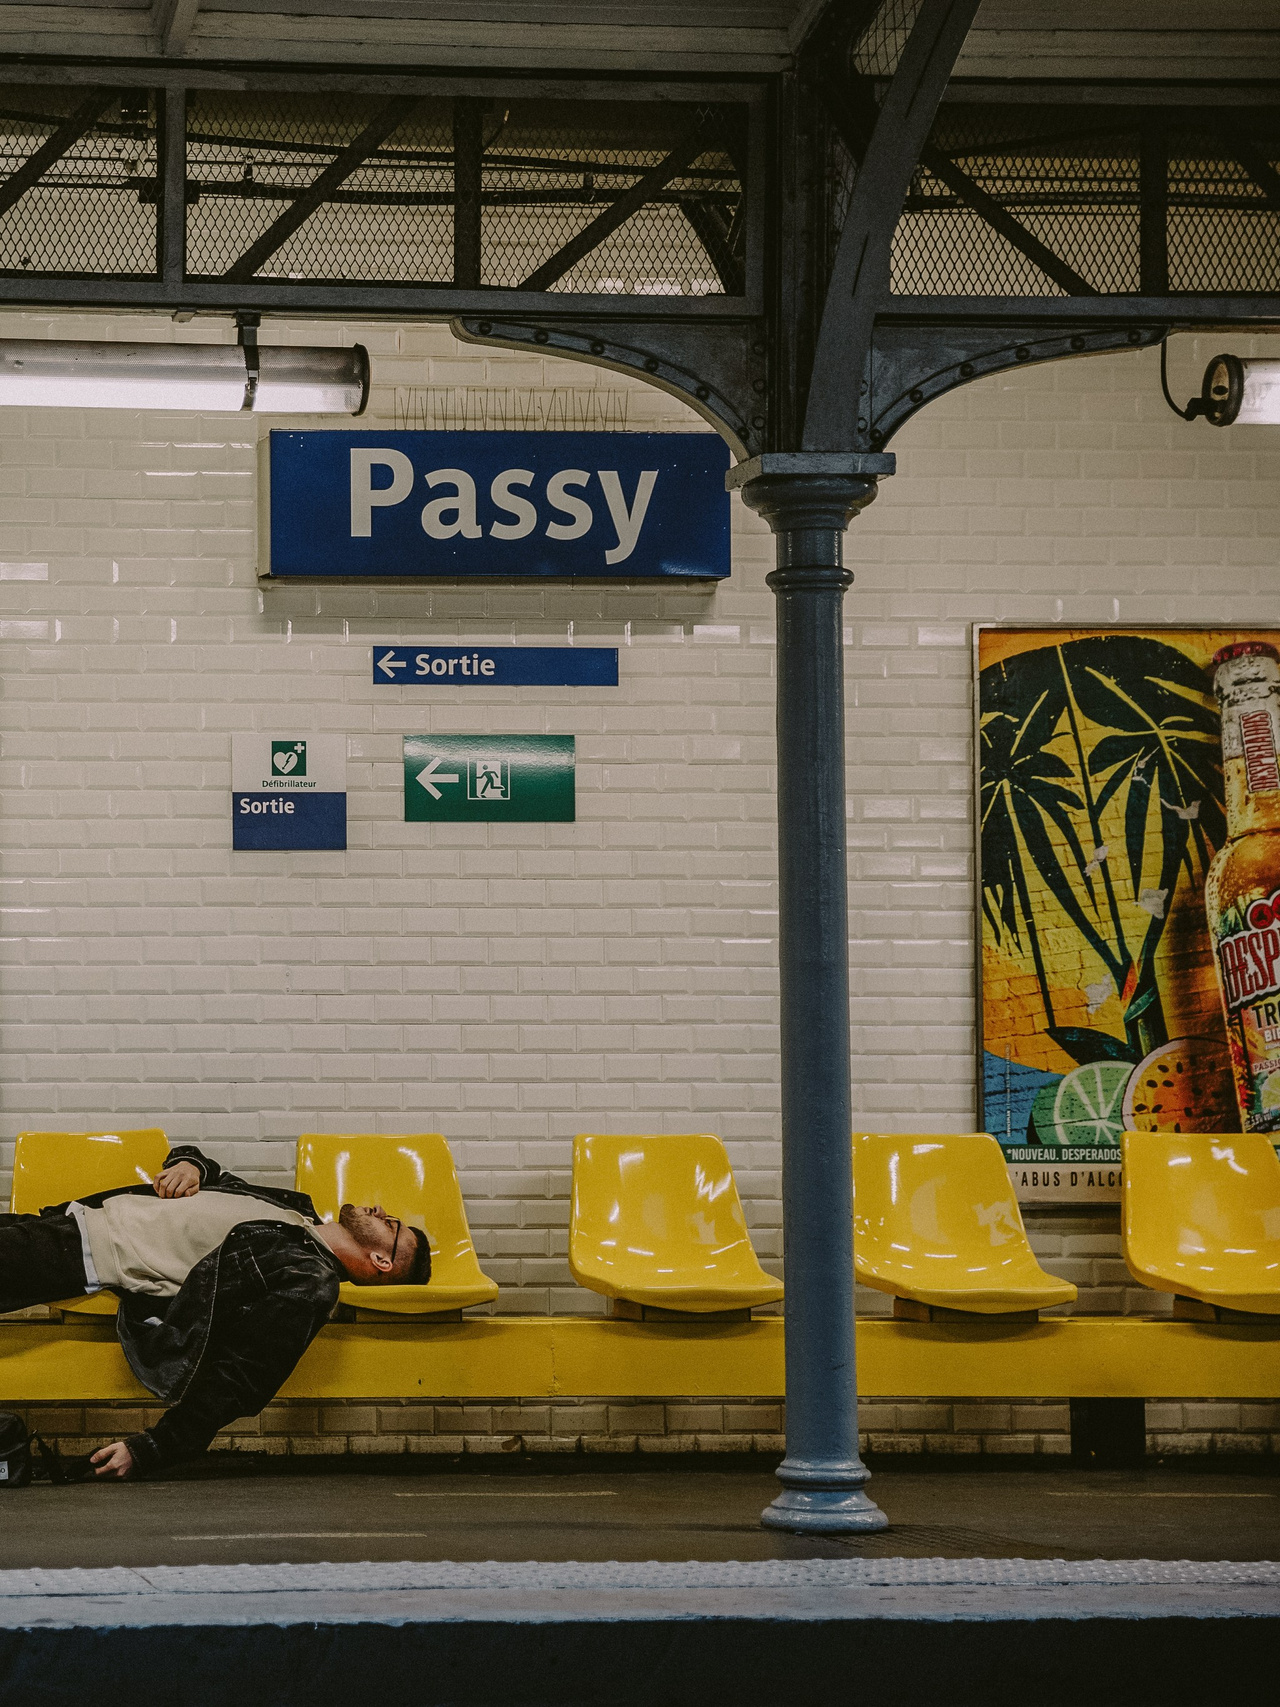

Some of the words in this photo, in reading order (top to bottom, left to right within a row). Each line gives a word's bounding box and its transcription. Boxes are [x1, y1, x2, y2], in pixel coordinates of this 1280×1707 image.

[349, 447, 659, 565] Passy
[414, 653, 496, 677] Sortie
[1241, 711, 1280, 792] DESPERADOS
[261, 779, 317, 789] Défibrillateur
[240, 797, 295, 815] Sortie
[1251, 1002, 1280, 1029] TR
[1061, 1148, 1122, 1161] DESPERADOS
